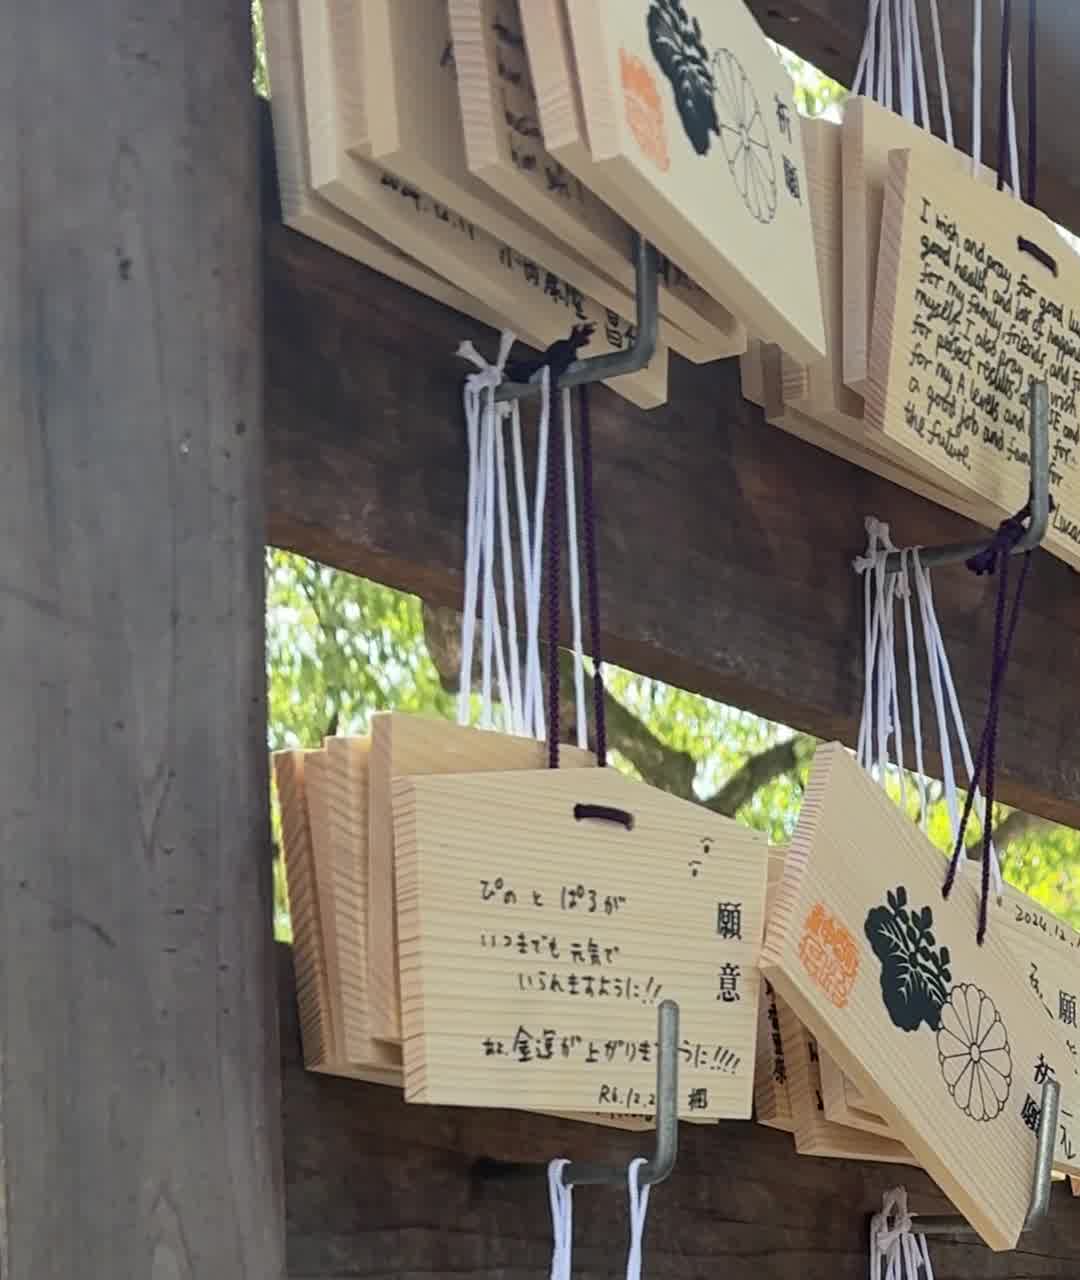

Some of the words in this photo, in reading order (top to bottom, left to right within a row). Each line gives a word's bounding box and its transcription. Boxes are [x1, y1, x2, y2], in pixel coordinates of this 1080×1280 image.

[919, 196, 931, 225] I
[935, 213, 960, 249] wish
[962, 237, 985, 263] and
[983, 254, 1012, 295] pray
[1016, 273, 1037, 299] for
[919, 261, 943, 288] for
[946, 280, 964, 322] my
[992, 289, 1013, 316] and
[911, 313, 933, 341] for
[903, 400, 926, 438] the
[909, 342, 933, 371] for
[935, 362, 953, 399] my
[1003, 407, 1026, 433] and
[926, 384, 957, 420] good
[982, 425, 1004, 452] and
[716, 901, 743, 1002] 願意
